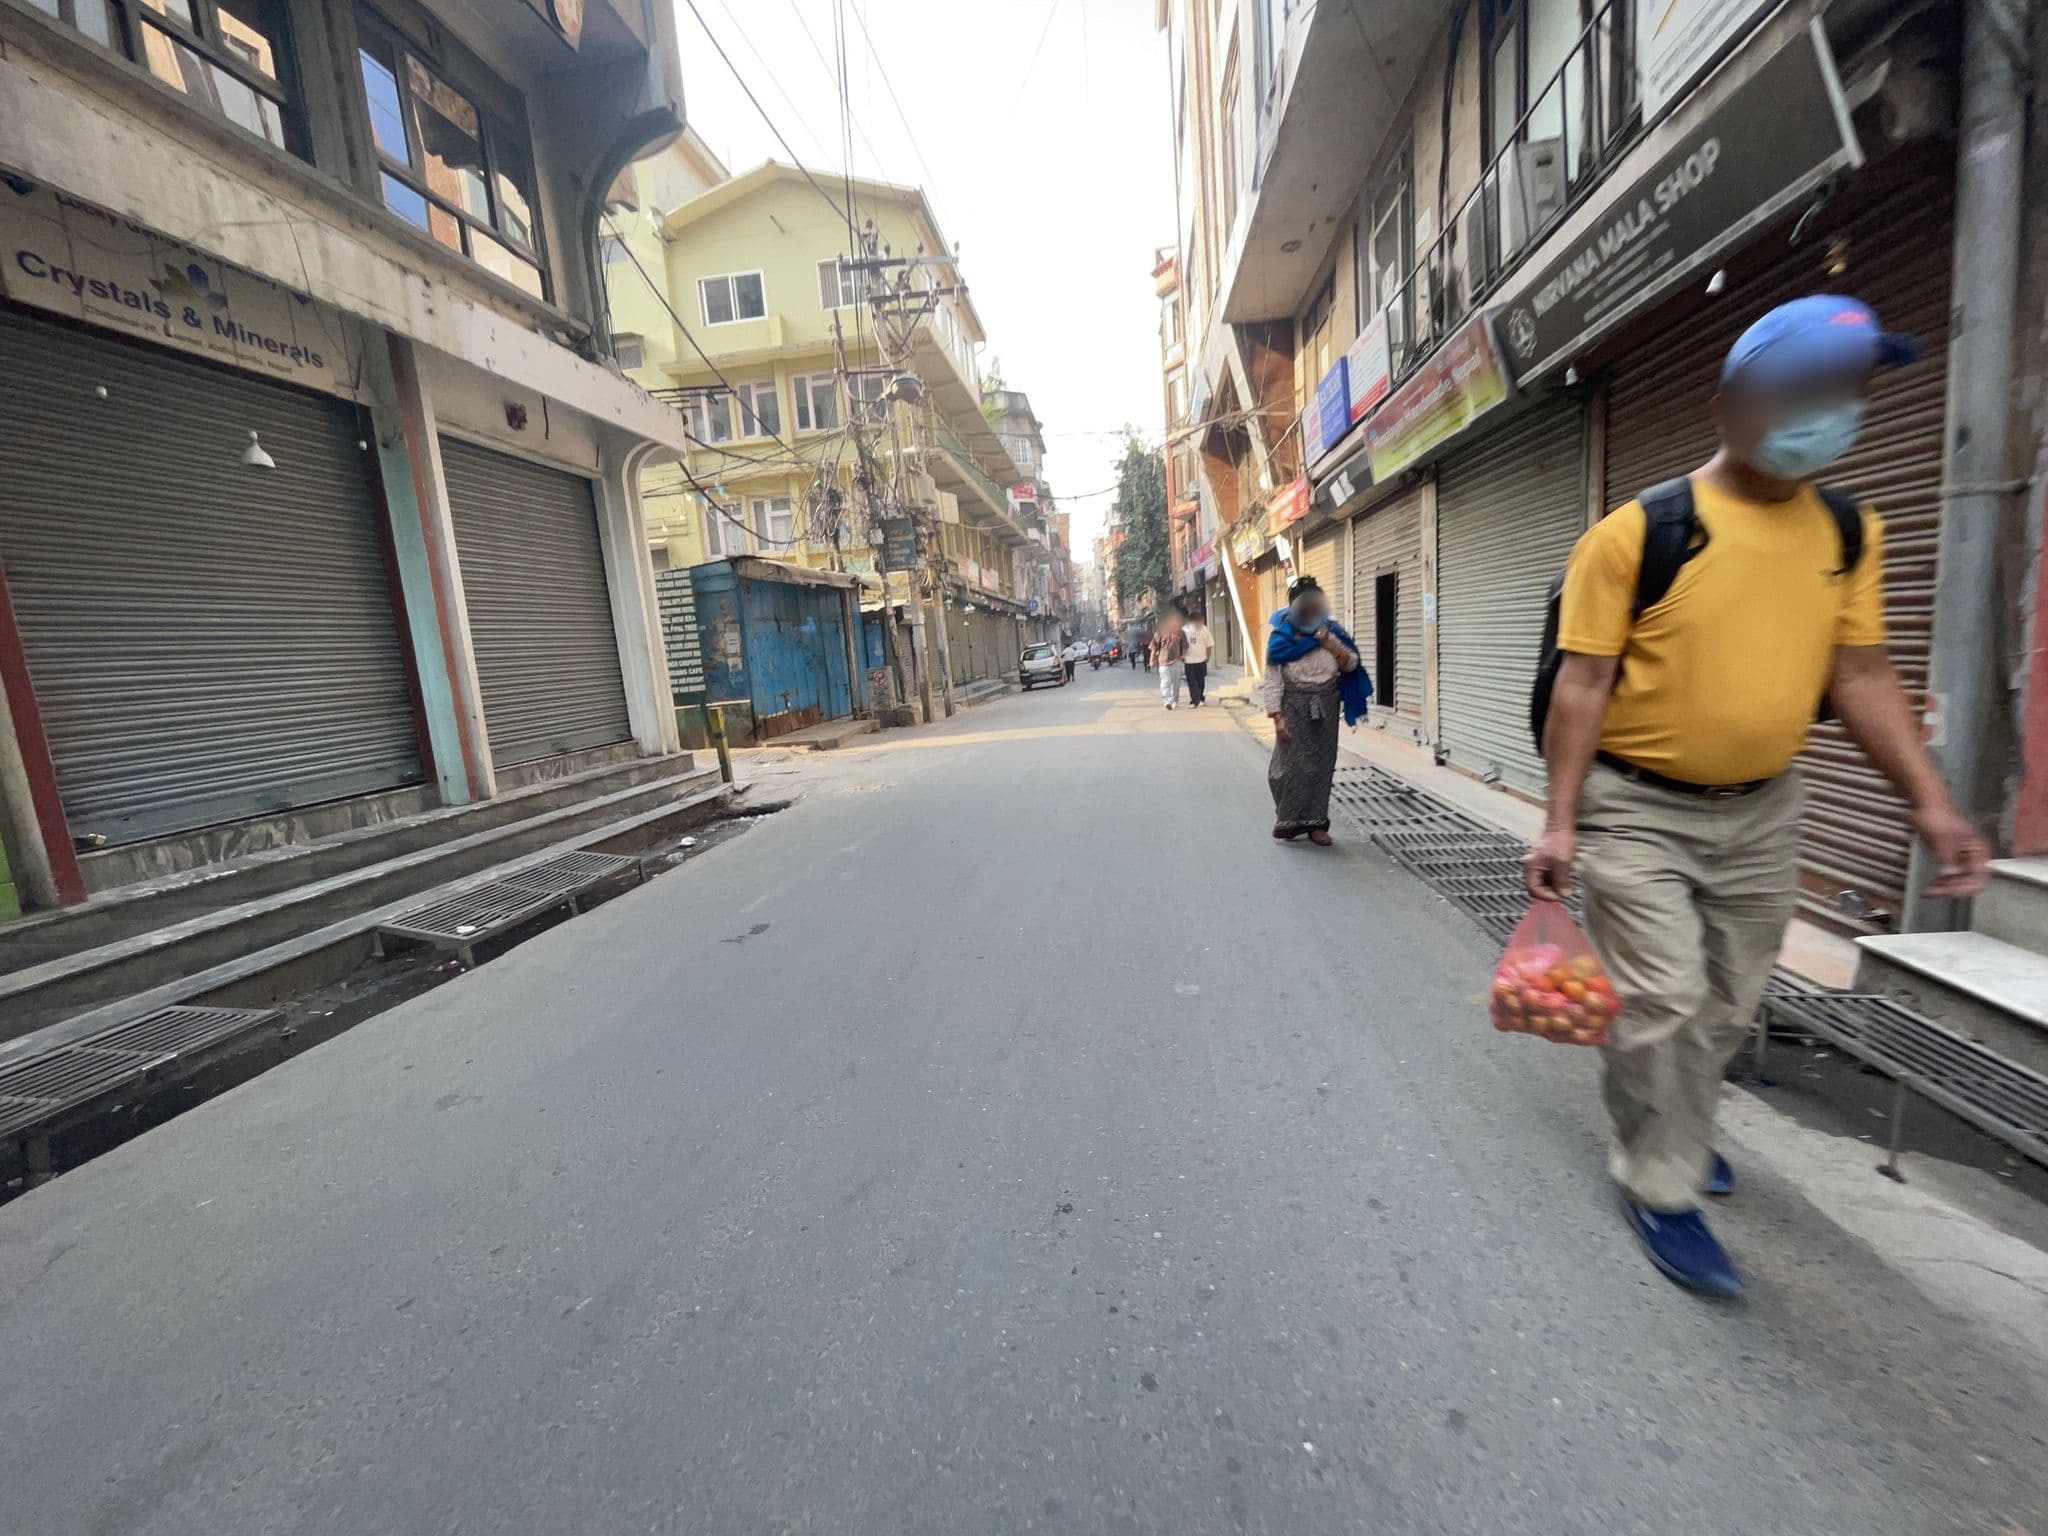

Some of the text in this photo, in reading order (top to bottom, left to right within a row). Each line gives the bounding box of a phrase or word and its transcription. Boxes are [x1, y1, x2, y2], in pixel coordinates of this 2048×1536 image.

[1654, 138, 1720, 214] SHOP
[16, 250, 172, 319] Crystals
[183, 303, 203, 330] &
[213, 315, 324, 368] Minerals
